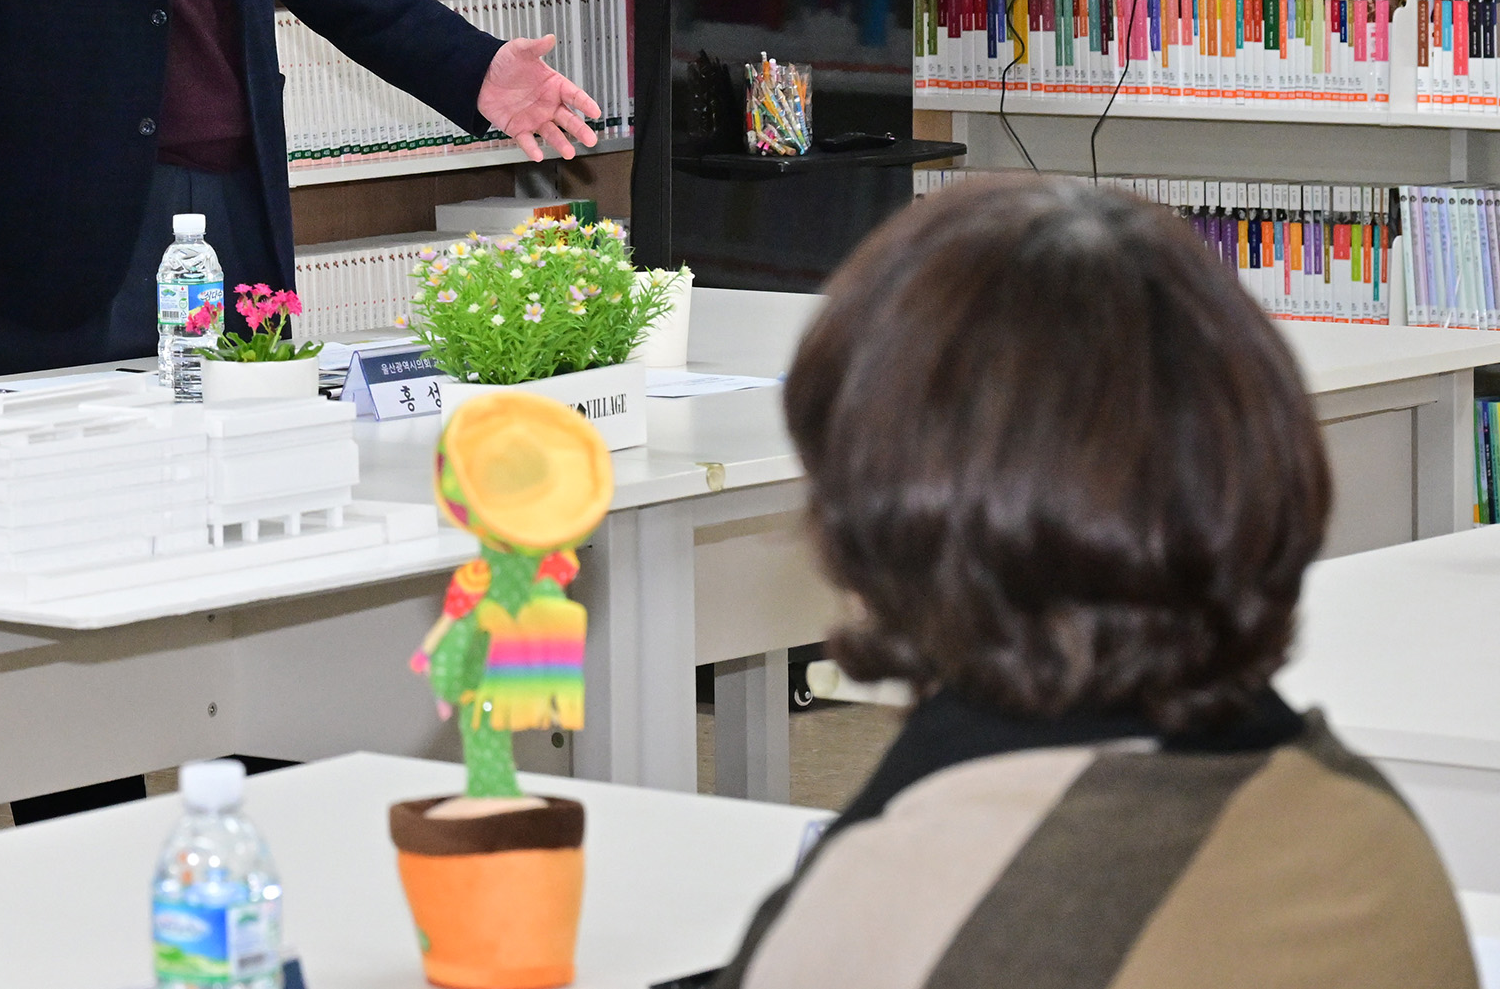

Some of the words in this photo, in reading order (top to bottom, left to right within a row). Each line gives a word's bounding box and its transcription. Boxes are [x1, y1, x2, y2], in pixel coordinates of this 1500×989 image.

[380, 357, 433, 375] 울산광역시의회
[399, 385, 415, 412] 홍
[586, 393, 628, 420] VILLAGE
